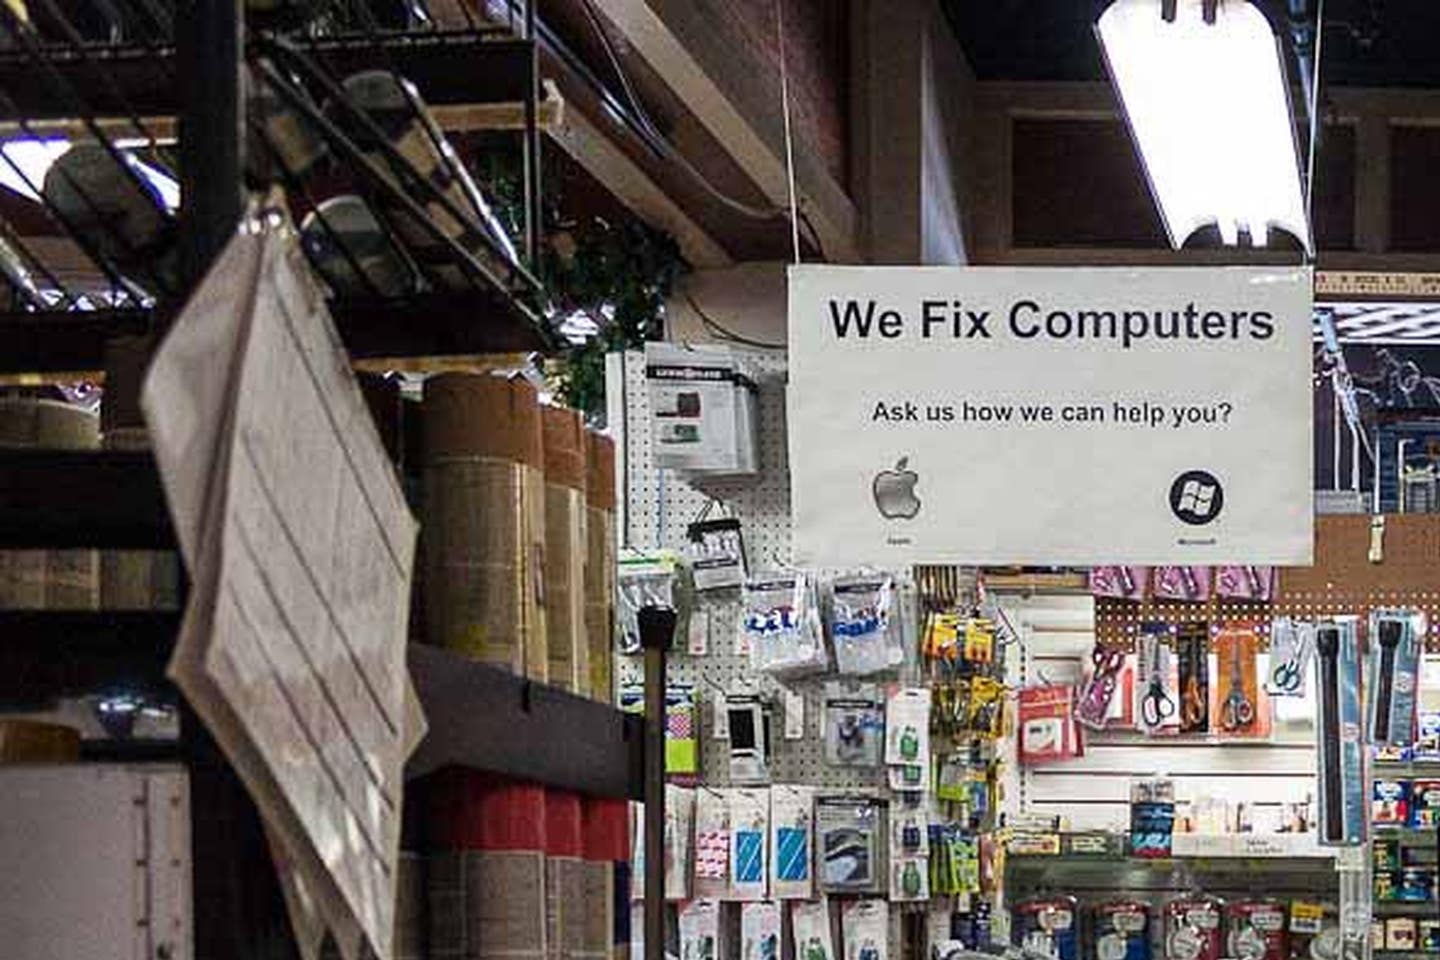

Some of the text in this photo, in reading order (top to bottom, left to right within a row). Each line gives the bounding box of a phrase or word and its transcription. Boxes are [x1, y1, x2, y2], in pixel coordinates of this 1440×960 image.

[829, 300, 1274, 349] We Fix Computers
[872, 401, 1232, 429] Ask us how we can help you?
